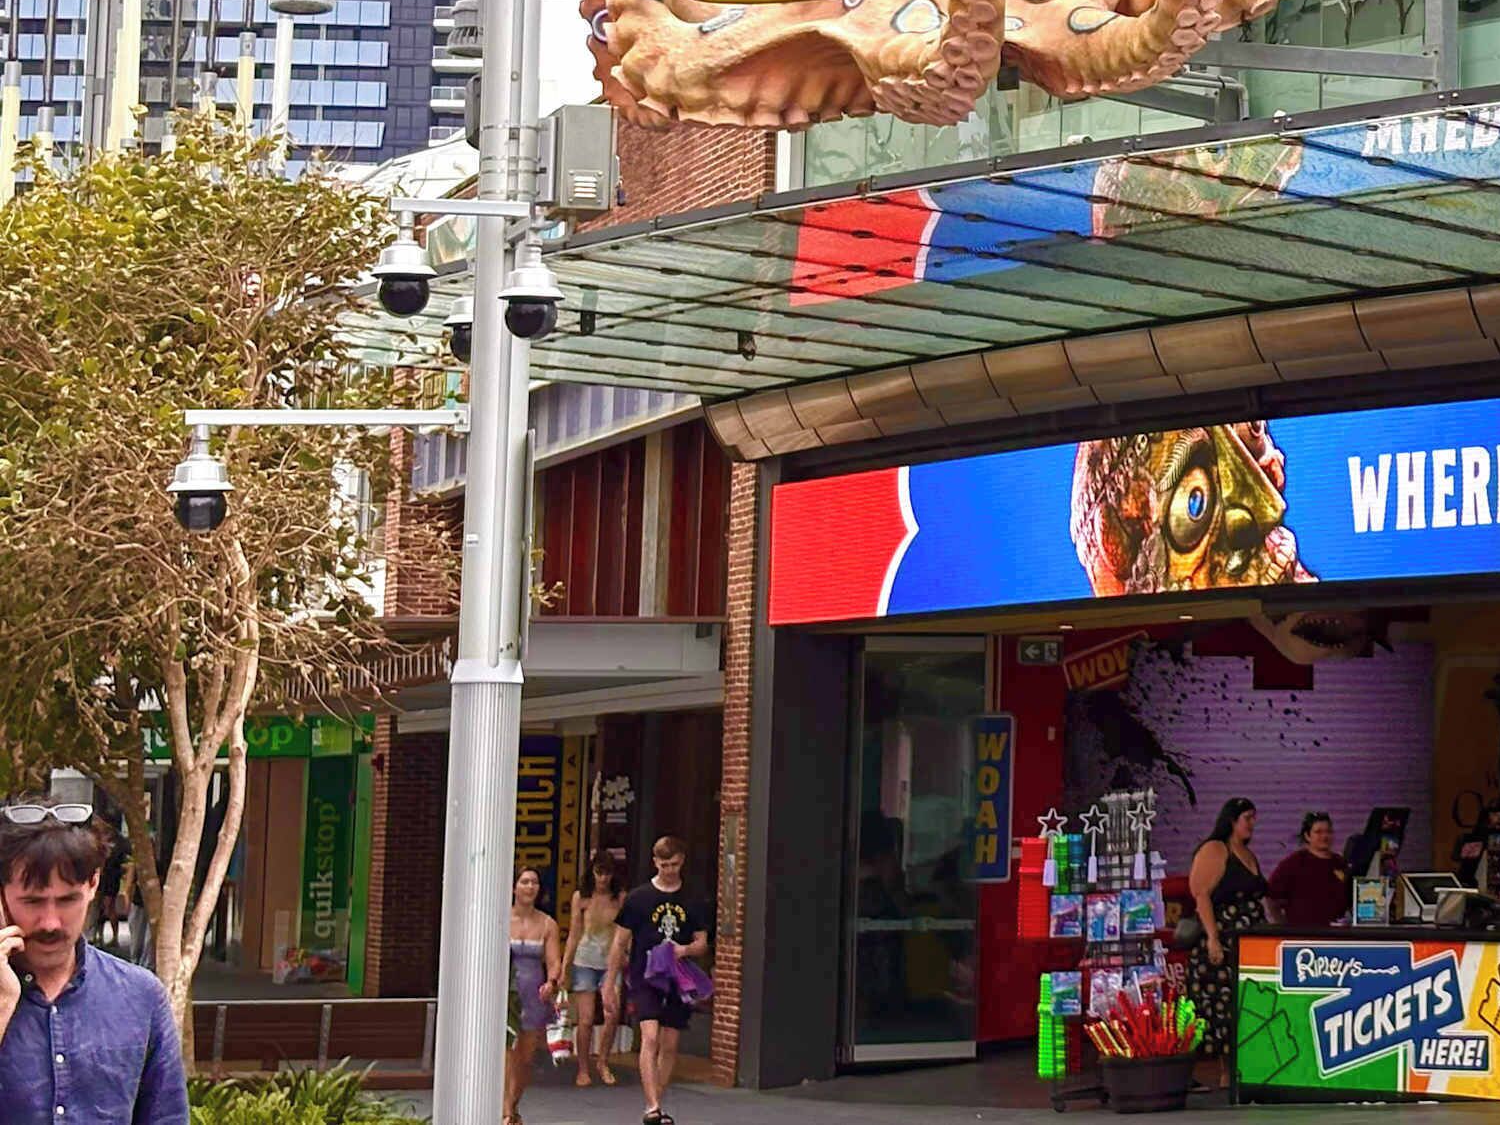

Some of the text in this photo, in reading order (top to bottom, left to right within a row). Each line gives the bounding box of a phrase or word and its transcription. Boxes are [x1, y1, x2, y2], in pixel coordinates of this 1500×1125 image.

[974, 732, 1008, 865] WOAH
[309, 801, 341, 940] quikstop
[1324, 969, 1452, 1057] TICKETS
[1420, 1039, 1485, 1067] HERE!
